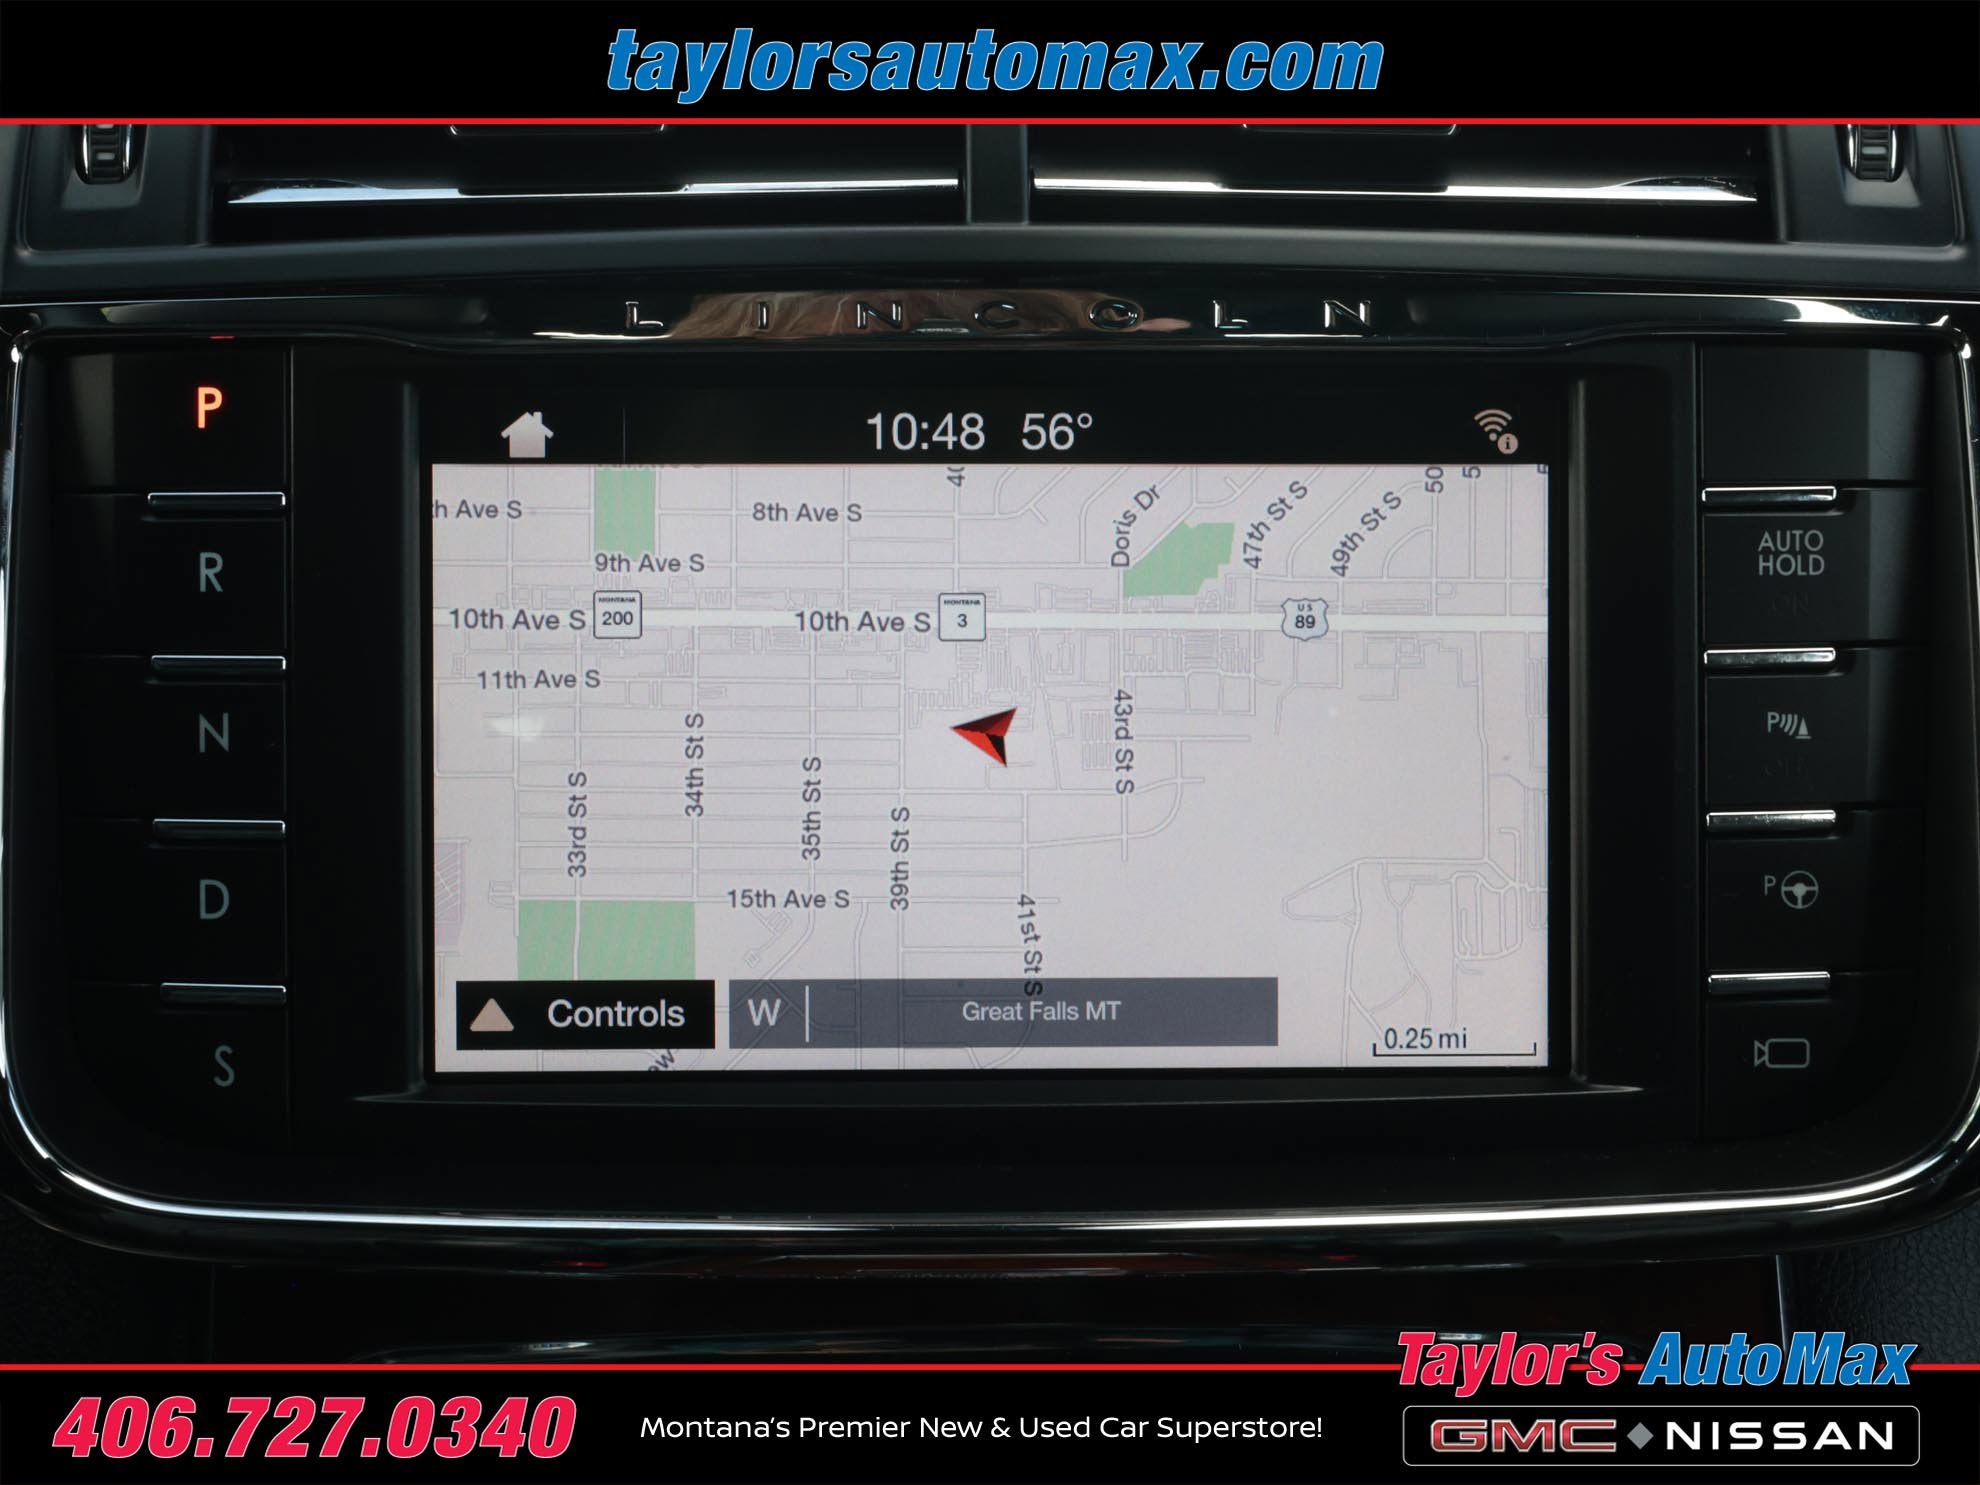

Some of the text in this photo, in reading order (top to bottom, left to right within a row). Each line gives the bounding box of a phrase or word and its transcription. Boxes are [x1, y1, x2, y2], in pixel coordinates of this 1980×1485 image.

[624, 300, 1372, 331] LINCOLN
[197, 386, 223, 429] P
[867, 412, 986, 451] 10:48
[432, 499, 523, 520] h Ave S
[752, 502, 862, 522] 8th Ave S
[1110, 484, 1160, 567] Doris Dr
[1243, 480, 1308, 570] 47th St S
[1330, 491, 1402, 578] 49th St S
[1758, 529, 1824, 552] AUTO
[199, 552, 223, 592] R
[594, 553, 705, 573] 9th Ave S
[1758, 553, 1825, 576] HOLD
[449, 607, 586, 631] 10th Ave S
[602, 610, 634, 626] 200
[795, 610, 931, 633] 10th Ave S
[957, 613, 968, 628] 3
[1294, 614, 1316, 629] 89
[477, 669, 601, 690] 11th Ave S
[199, 713, 229, 753] N
[1767, 711, 1780, 733] P
[1114, 689, 1135, 795] 43rd St S
[684, 713, 704, 817] 34th St S
[801, 756, 822, 861] 35th St S
[567, 771, 587, 878] 33rd St S
[890, 806, 910, 911] 39th St S
[199, 879, 229, 919] D
[727, 888, 850, 909] 15th Ave S
[1764, 875, 1777, 895] P
[1017, 894, 1044, 998] 41st St S
[548, 999, 685, 1027] Controls
[748, 998, 781, 1026] W
[962, 1000, 1122, 1021] Great Falls MT
[1384, 1027, 1467, 1050] 0.25 mi
[215, 1046, 234, 1087] S
